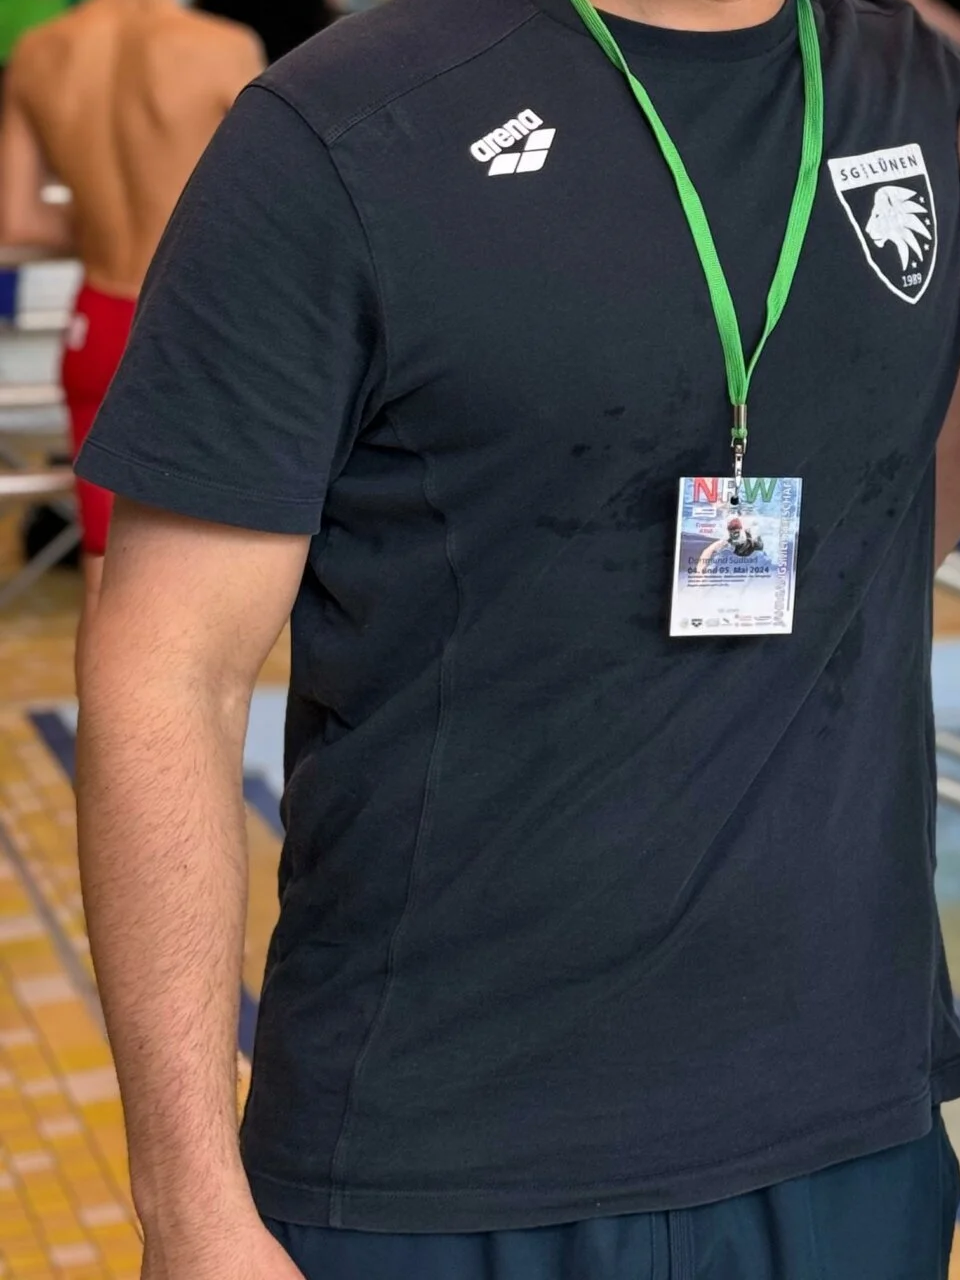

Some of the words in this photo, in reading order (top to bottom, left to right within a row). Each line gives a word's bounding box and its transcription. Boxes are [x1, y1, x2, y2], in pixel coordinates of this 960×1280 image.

[470, 108, 544, 162] arena
[840, 167, 860, 181] SG
[868, 155, 918, 175] LÜNEN
[902, 272, 922, 288] 1989
